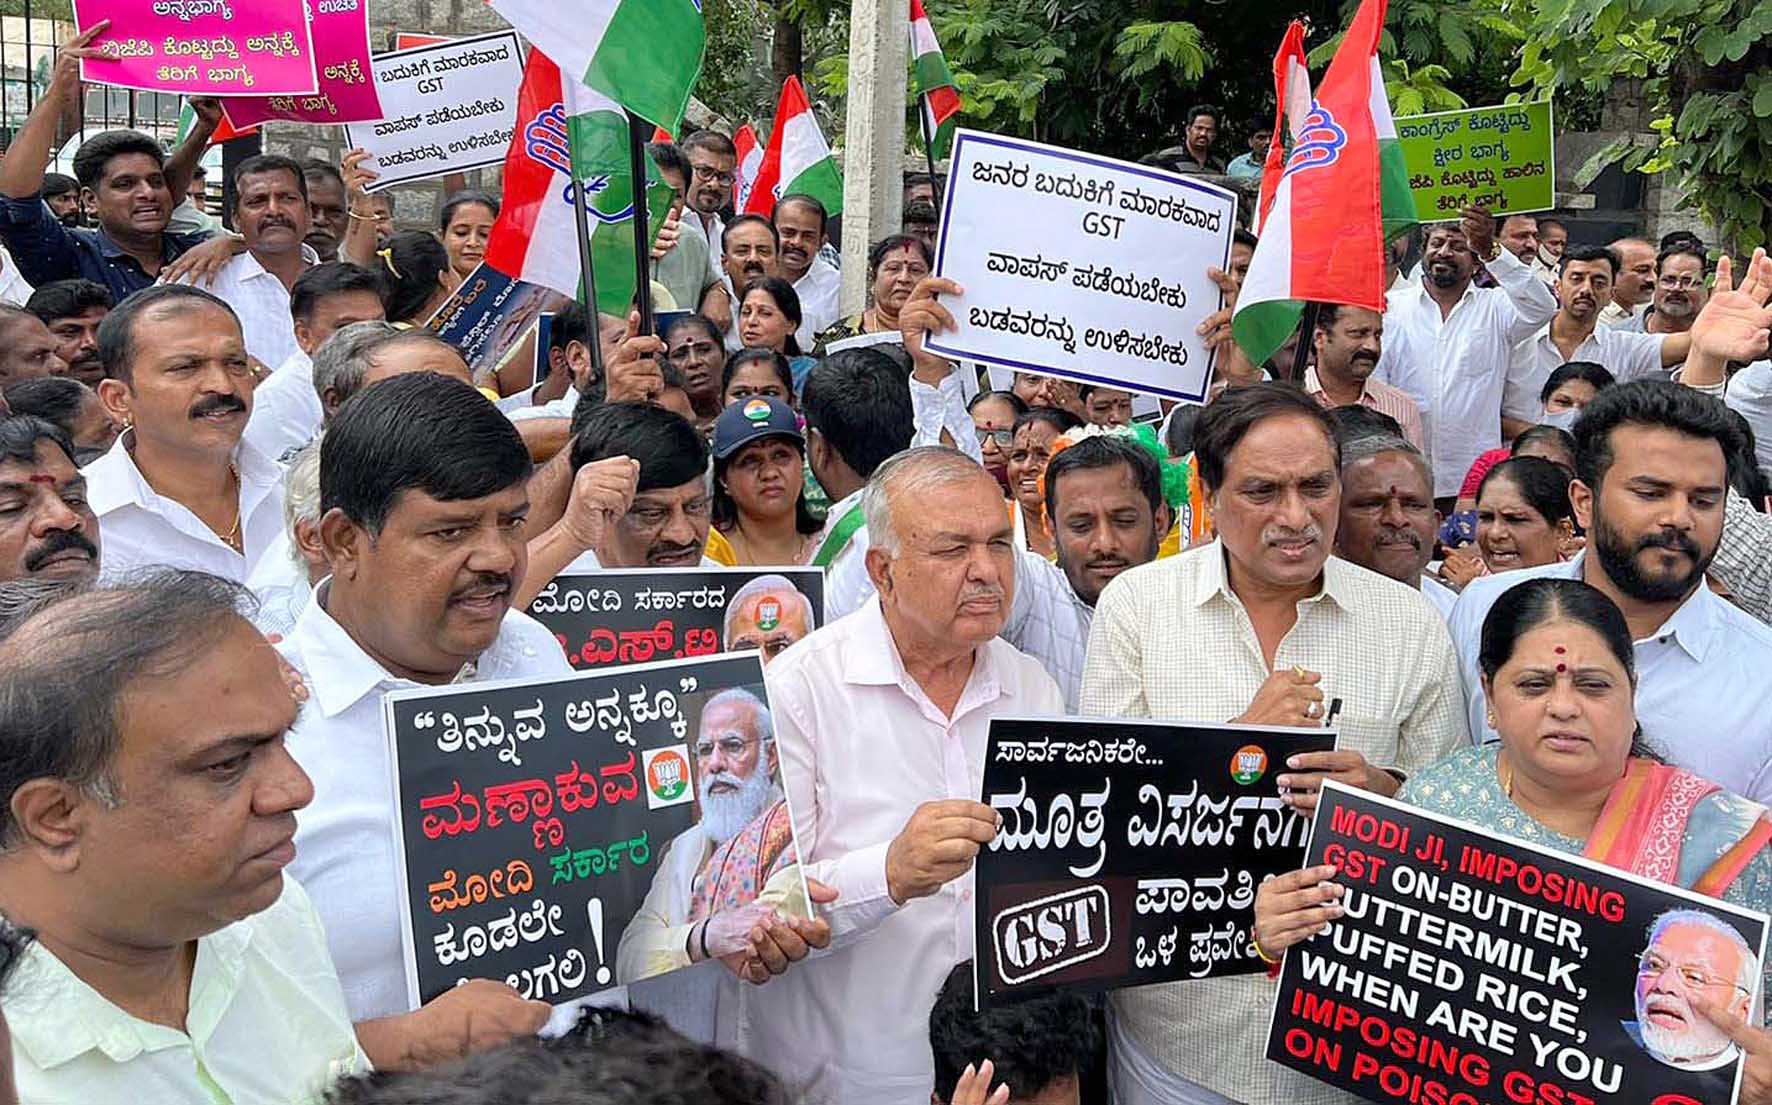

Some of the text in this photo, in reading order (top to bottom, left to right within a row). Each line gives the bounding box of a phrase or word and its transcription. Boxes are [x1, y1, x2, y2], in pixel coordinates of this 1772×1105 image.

[247, 31, 300, 56] ಅನ್ನಕ್ಕೆ
[380, 59, 431, 83] ಬದುಕಿಗೆ
[433, 44, 510, 74] ಮಾರಕವಾದ
[157, 64, 255, 86] ತೆರಿಗೆ ಭಾಗ್ಯ
[417, 77, 444, 94] GST
[374, 97, 505, 136] ವಾಪಸ್ ಪಡೆಯಬೇಕು
[378, 143, 448, 169] ಬಡವರನ್ನು
[971, 160, 1222, 233] ಜನರ ಬದುಕಿಗೆ ಮಾರಕವಾದ
[1082, 211, 1126, 240] GST
[986, 252, 1187, 310] ವಾಪಸ್ ಪಡೆಯಬೇಕು
[969, 306, 1188, 366] ಬಡವರನ್ನು ಉಳಿಸಬೇಕು
[532, 583, 726, 614] ಮೋದಿ ಸರ್ಕಾರದ
[987, 776, 1111, 878] ಮೂತ್ರ
[428, 829, 651, 915] ಮೋದಿ ಸರ್ಕಾರ
[1329, 804, 1627, 922] MODI JI, IMPOSING
[1323, 843, 1589, 958] GST ON-BUTTER,
[433, 898, 564, 966] ಕೂಡಲೇ
[1003, 896, 1097, 968] GST
[1136, 925, 1178, 969] ಒಳ
[1318, 881, 1589, 998] UTTERMILK,
[1292, 987, 1490, 1086] IMPOSING
[1301, 950, 1624, 1094] WHEN ARE YOU
[1474, 977, 1589, 1045] RICE,
[1285, 1029, 1341, 1074] ON
